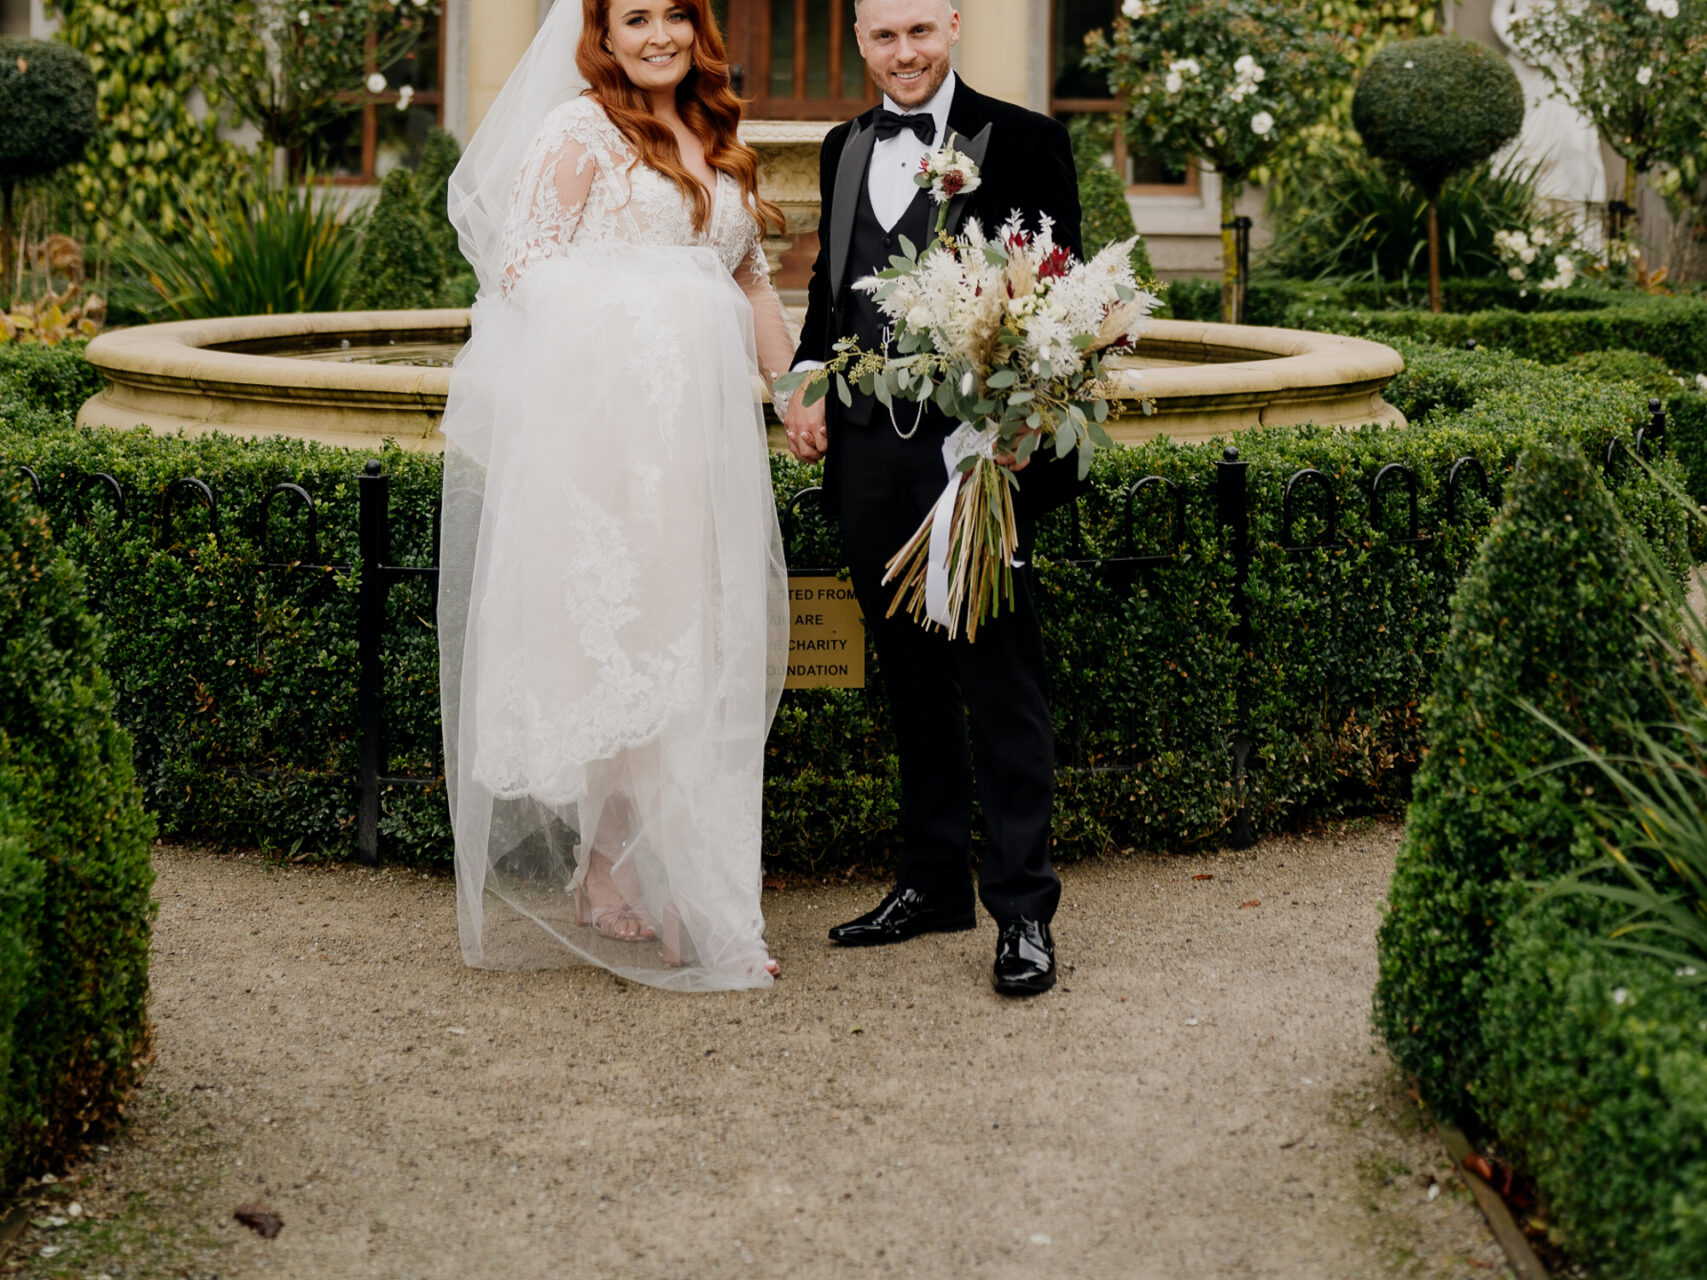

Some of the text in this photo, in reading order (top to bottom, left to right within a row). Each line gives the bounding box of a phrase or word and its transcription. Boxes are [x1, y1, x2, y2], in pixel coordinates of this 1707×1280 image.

[818, 589, 858, 600] FROM
[795, 614, 824, 626] ARE
[788, 639, 848, 651] CHARITY
